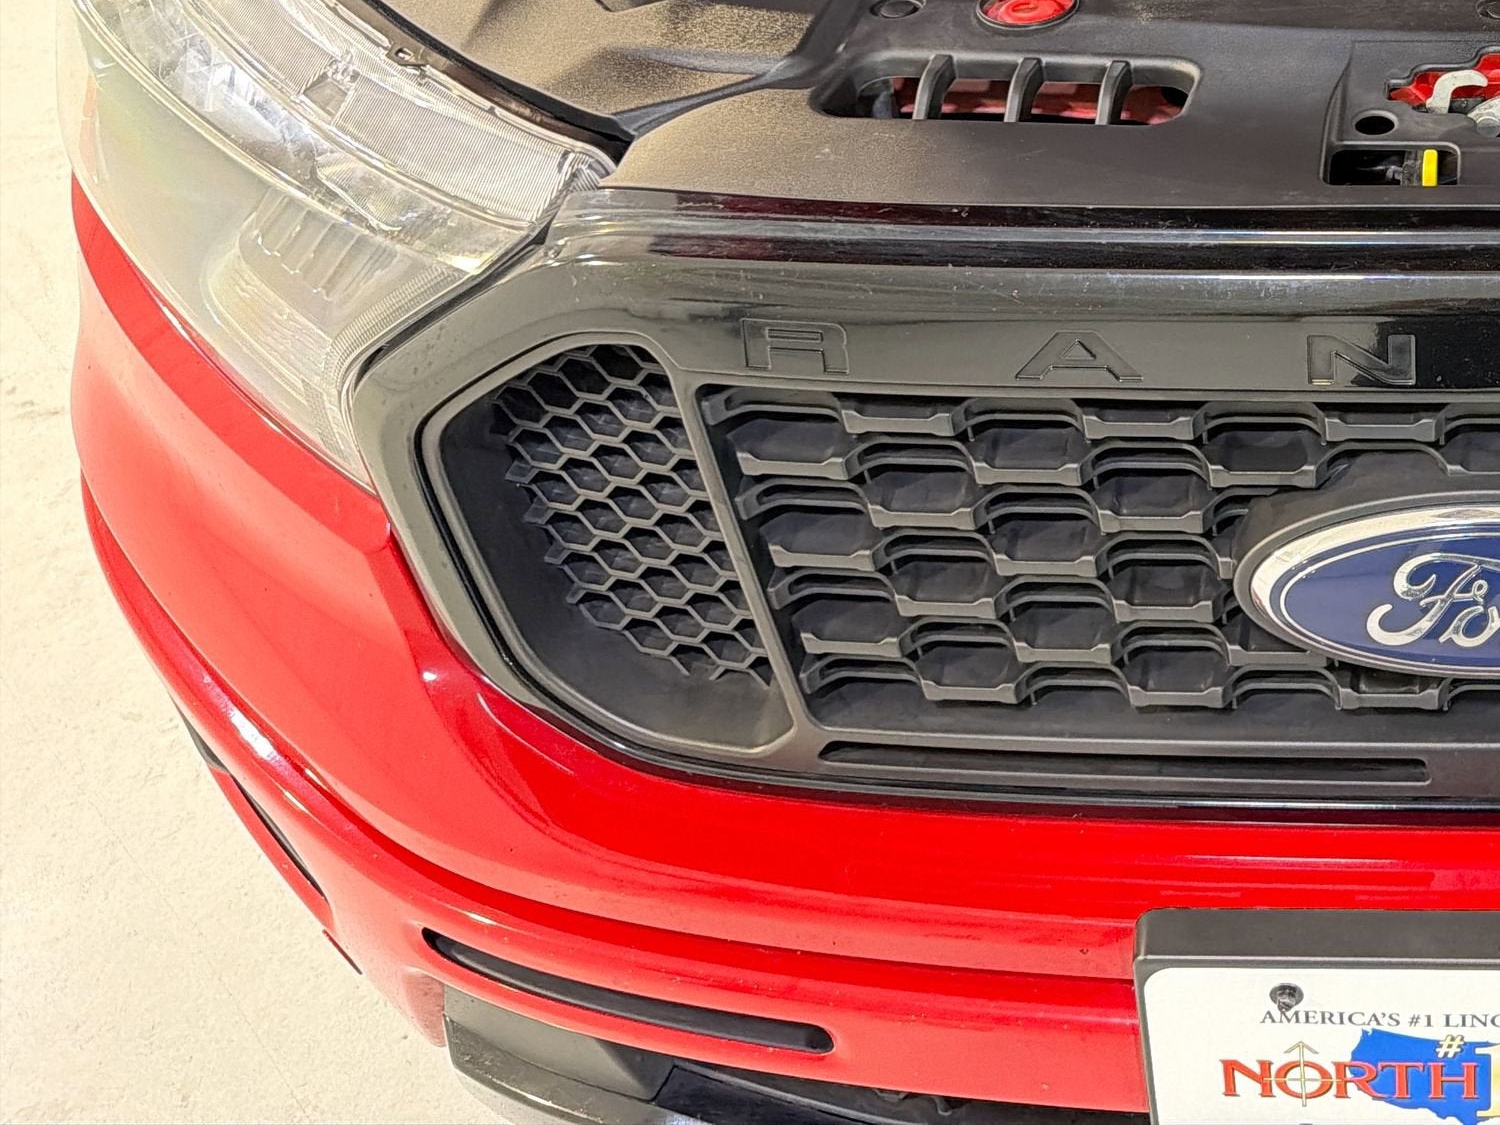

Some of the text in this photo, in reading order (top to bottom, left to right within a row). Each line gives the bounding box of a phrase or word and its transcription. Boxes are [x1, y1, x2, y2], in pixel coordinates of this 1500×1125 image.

[1260, 1009, 1401, 1027] AMERICA'S
[1408, 1013, 1434, 1028] #1
[1219, 1059, 1479, 1100] NORTH
